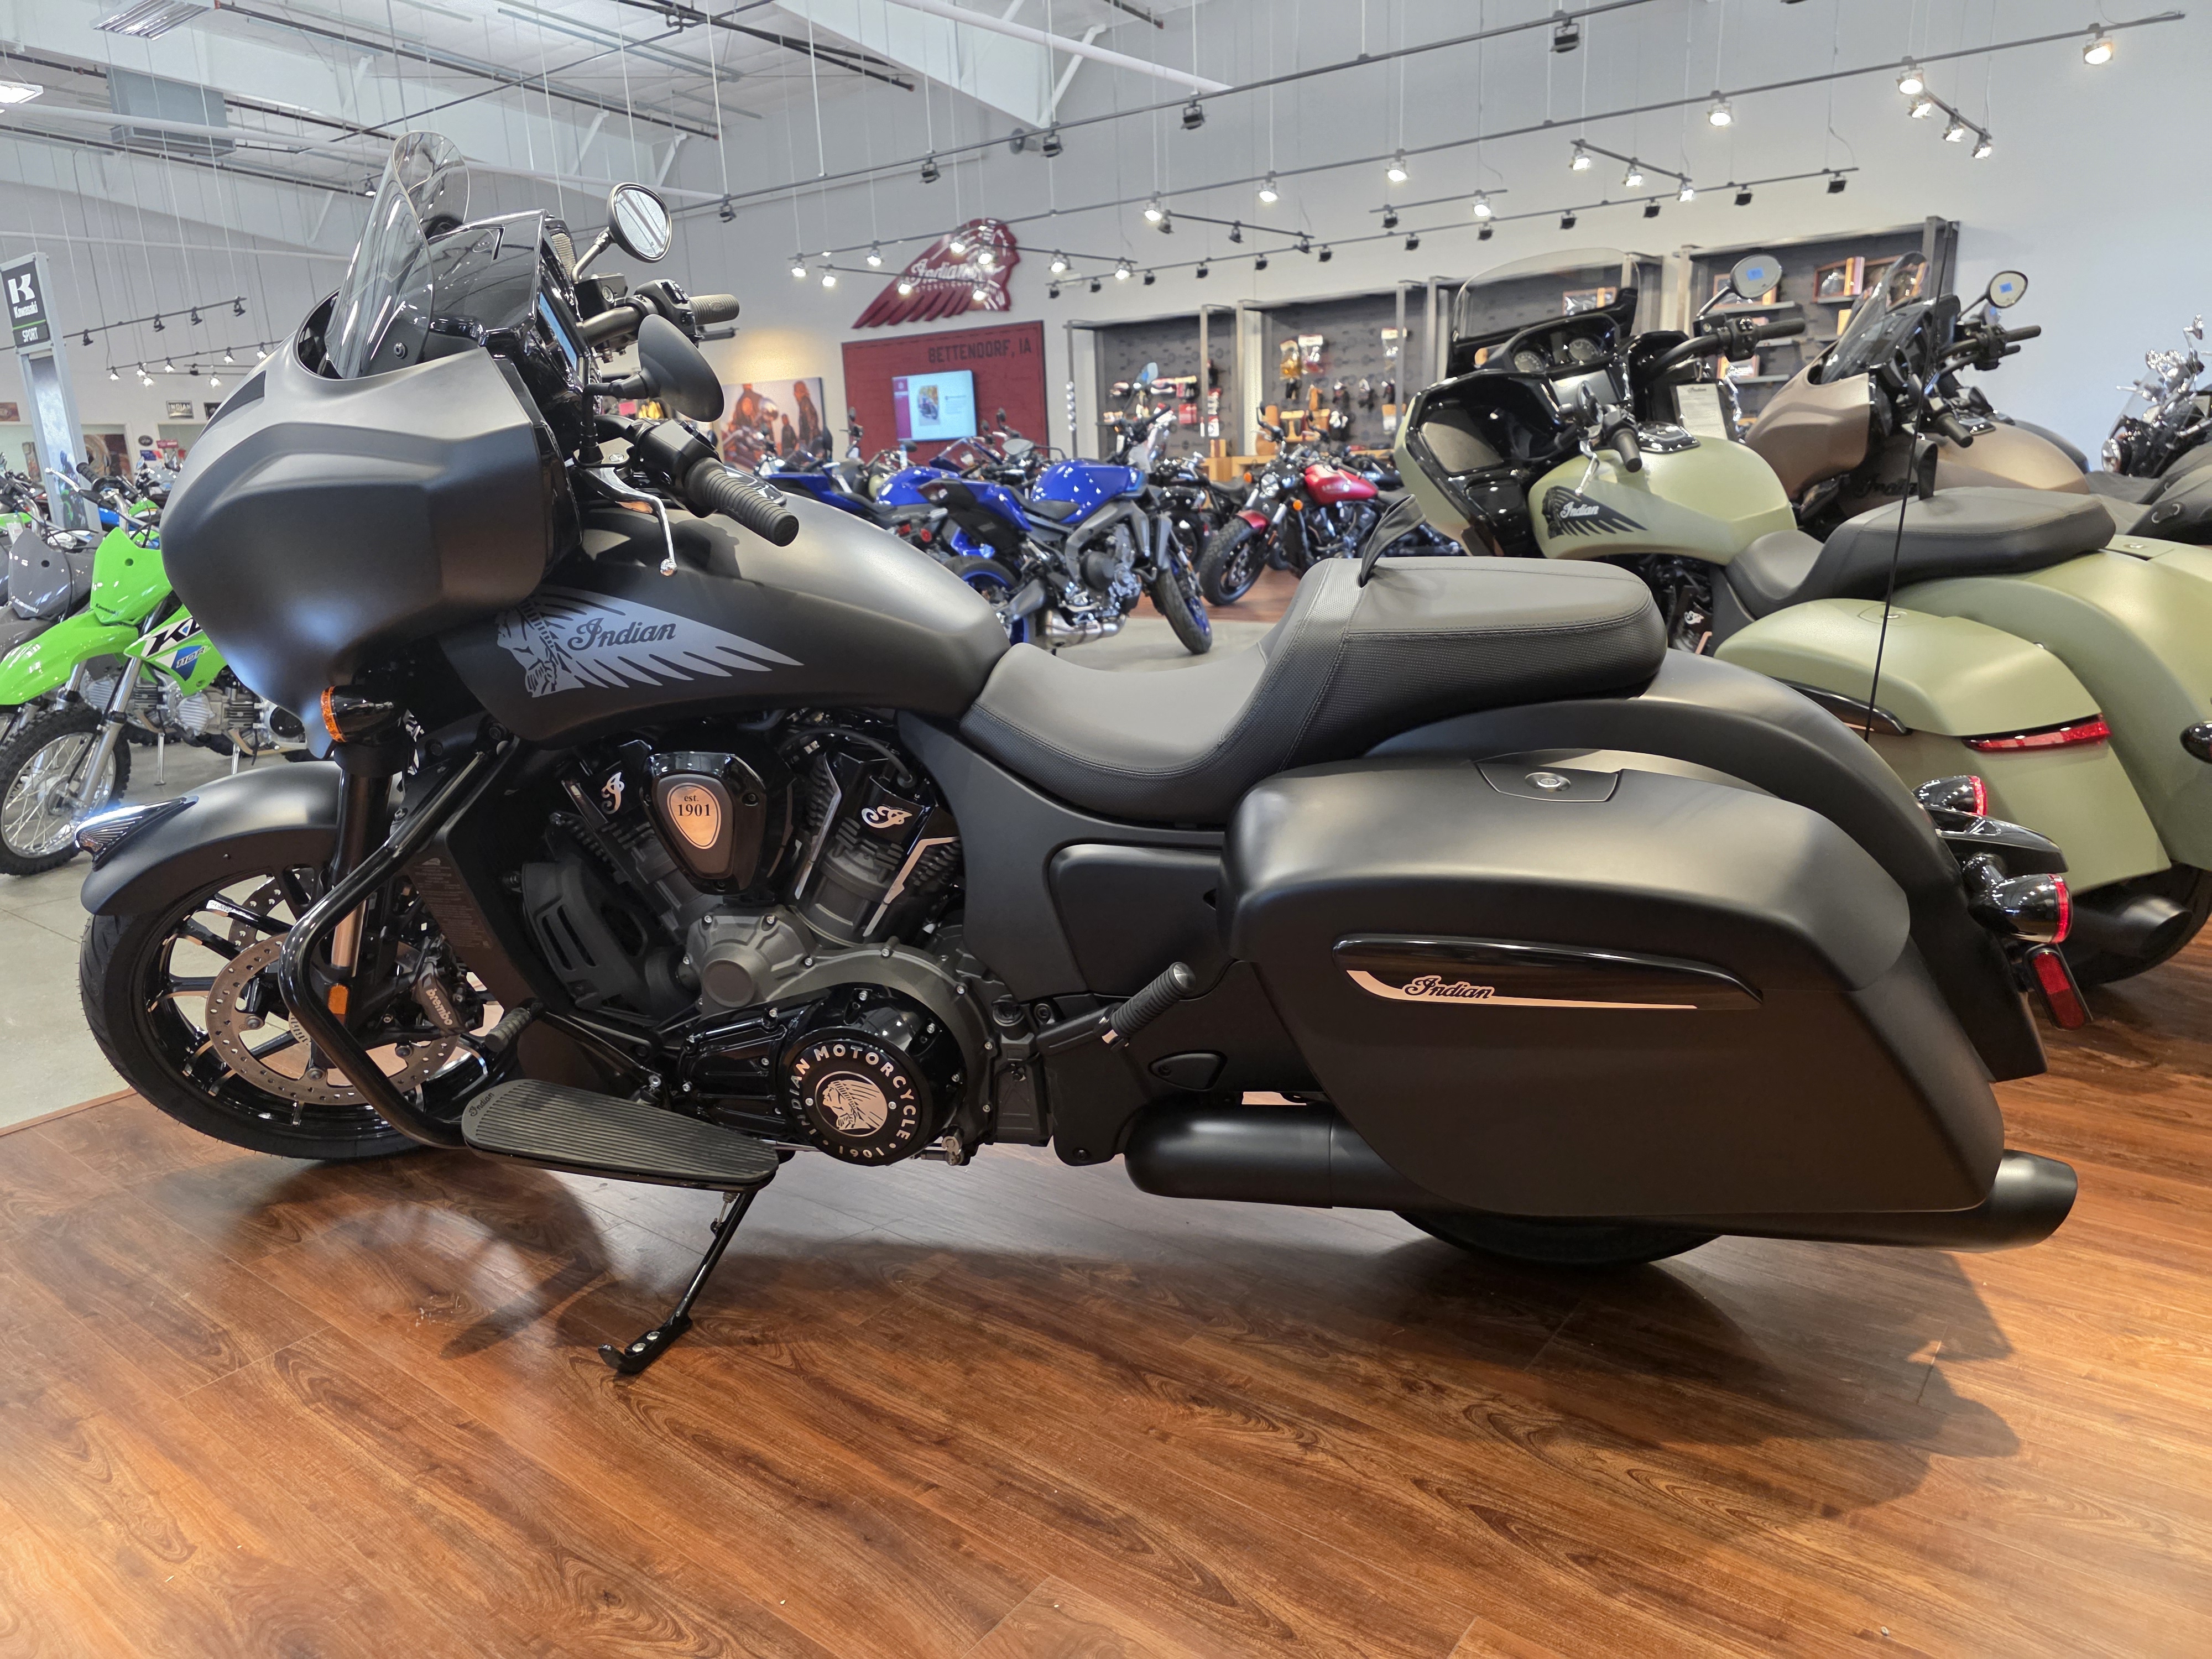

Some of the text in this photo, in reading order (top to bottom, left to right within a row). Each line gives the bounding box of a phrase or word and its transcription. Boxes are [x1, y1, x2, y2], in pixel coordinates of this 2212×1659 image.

[14, 301, 38, 319] Kawasaki
[22, 327, 38, 342] SPORT
[1019, 337, 1031, 354] IA
[1560, 502, 1599, 518] Indian
[567, 617, 676, 651] Indian
[677, 804, 711, 816] 1901
[1405, 978, 1492, 999] Indian
[426, 988, 453, 1025] brembo
[789, 1044, 916, 1140] INDIAN MOTORCYCLE
[468, 1092, 494, 1117] Indian
[839, 1145, 885, 1159] 1901
